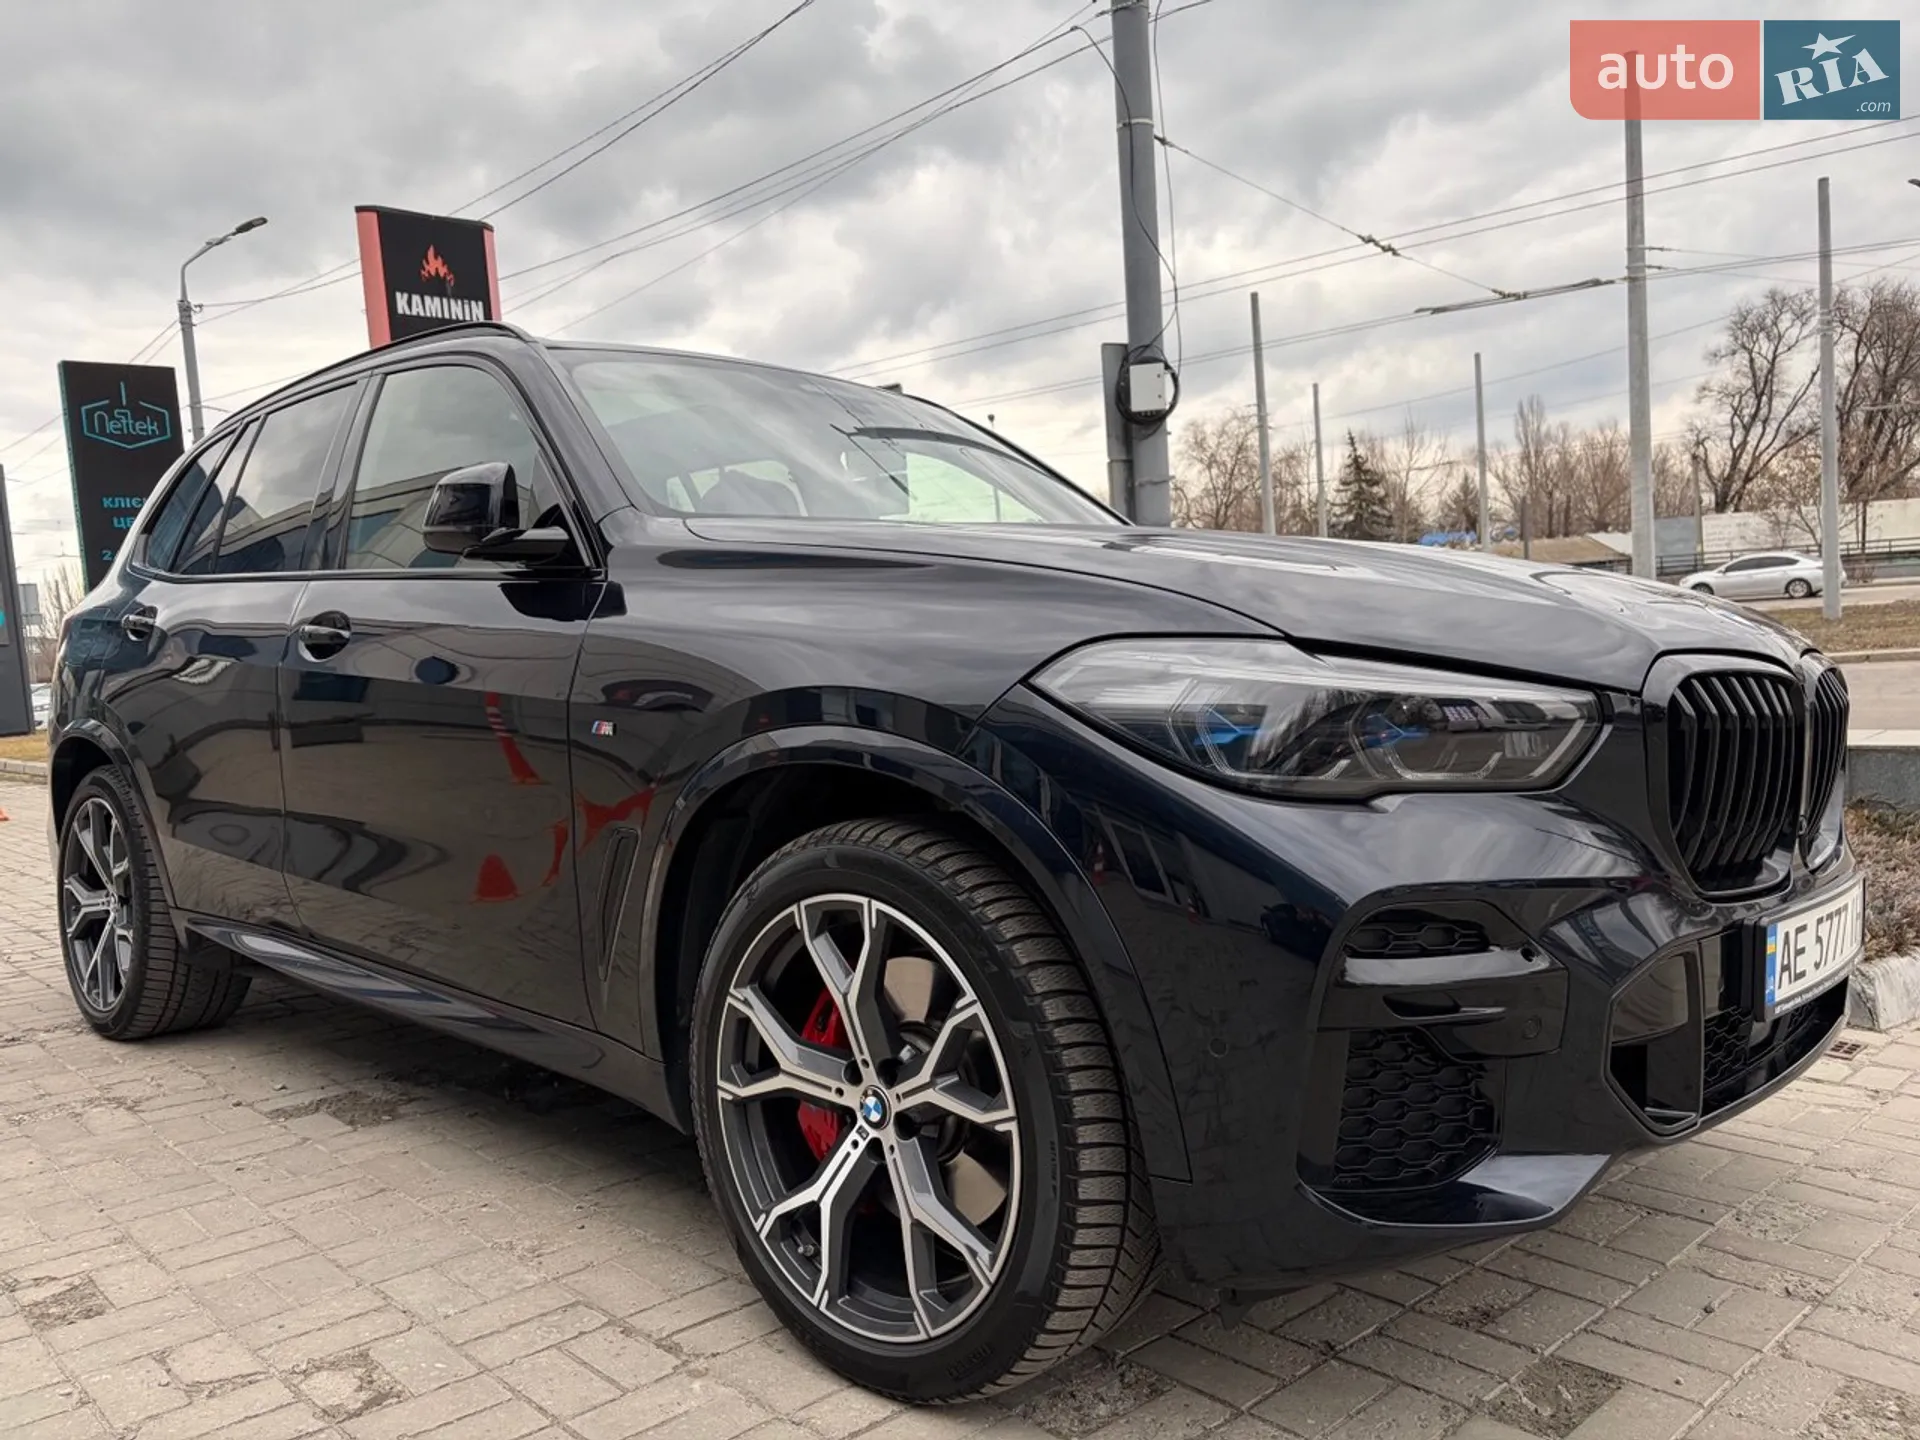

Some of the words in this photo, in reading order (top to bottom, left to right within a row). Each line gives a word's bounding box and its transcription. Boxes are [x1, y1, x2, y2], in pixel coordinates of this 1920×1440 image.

[102, 496, 147, 509] КЛІЄ
[1778, 924, 1808, 989] AE
[1813, 903, 1849, 970] 5777
